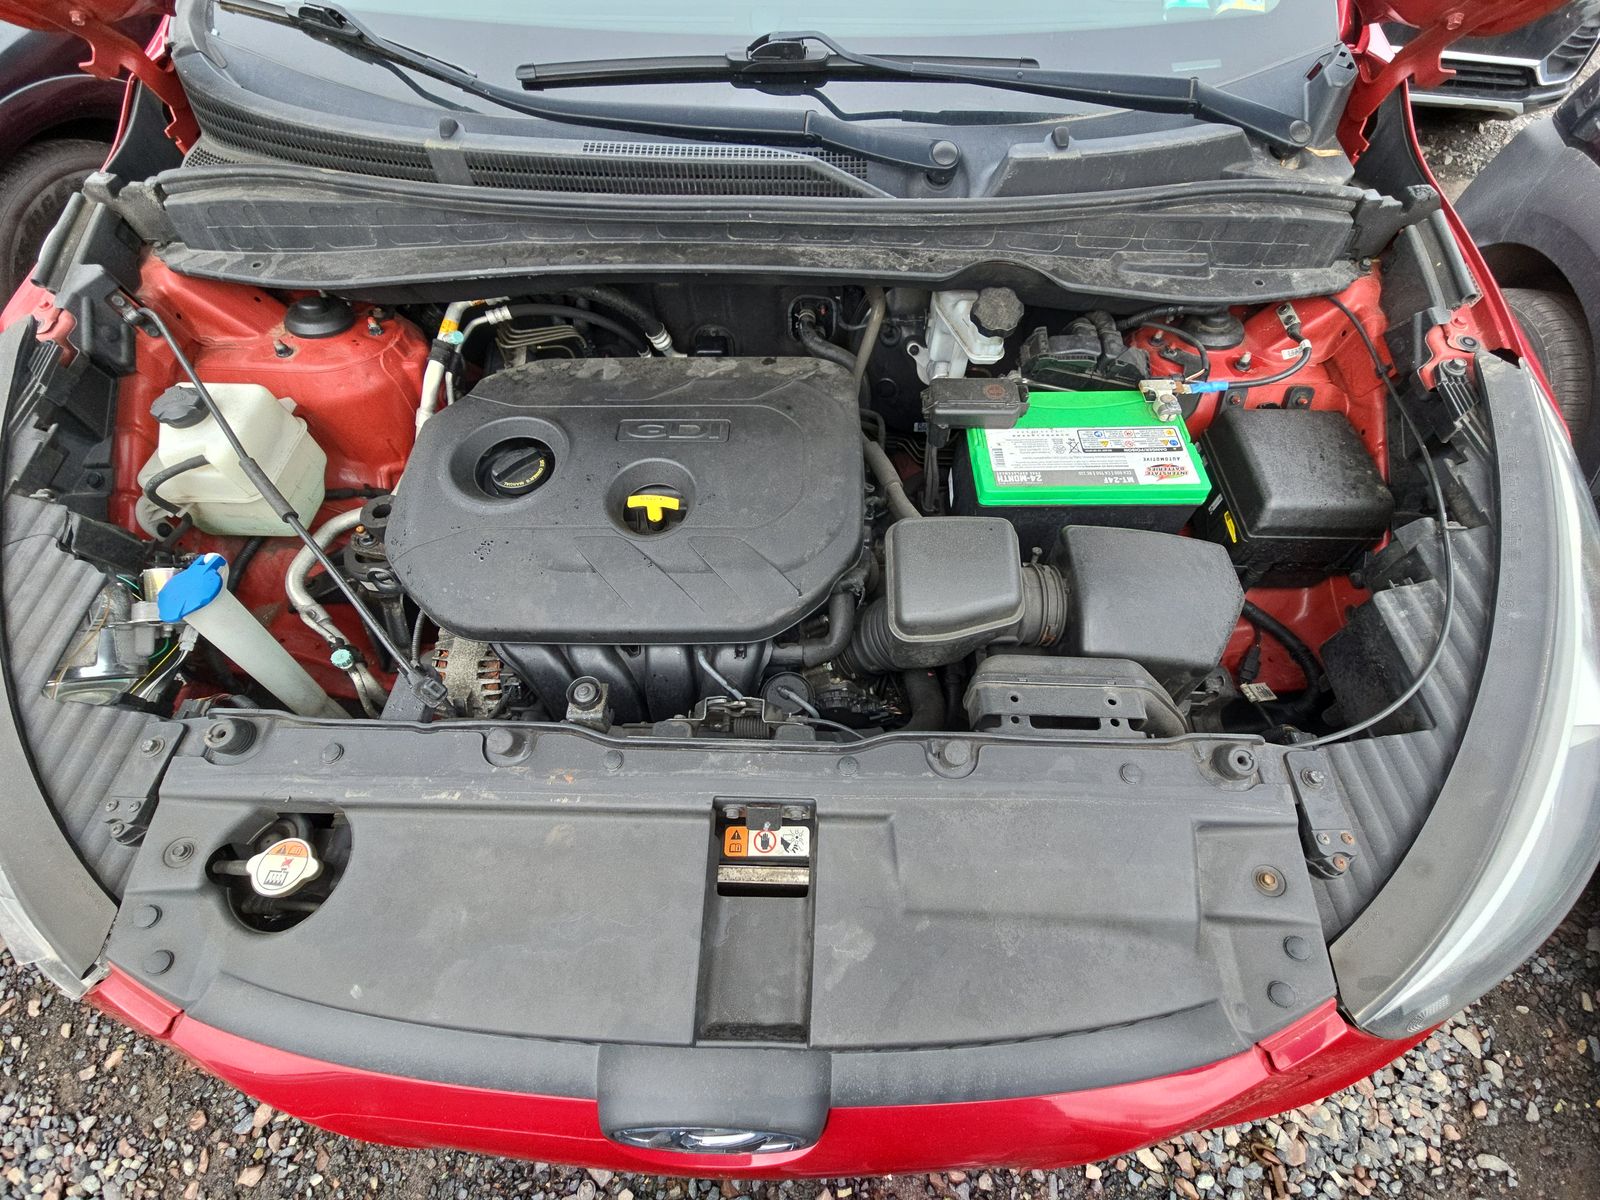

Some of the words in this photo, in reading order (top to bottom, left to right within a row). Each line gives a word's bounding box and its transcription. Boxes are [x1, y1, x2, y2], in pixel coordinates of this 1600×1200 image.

[624, 423, 720, 440] GDI
[996, 474, 1043, 482] 24-MONTH
[1103, 476, 1135, 484] MT-24F
